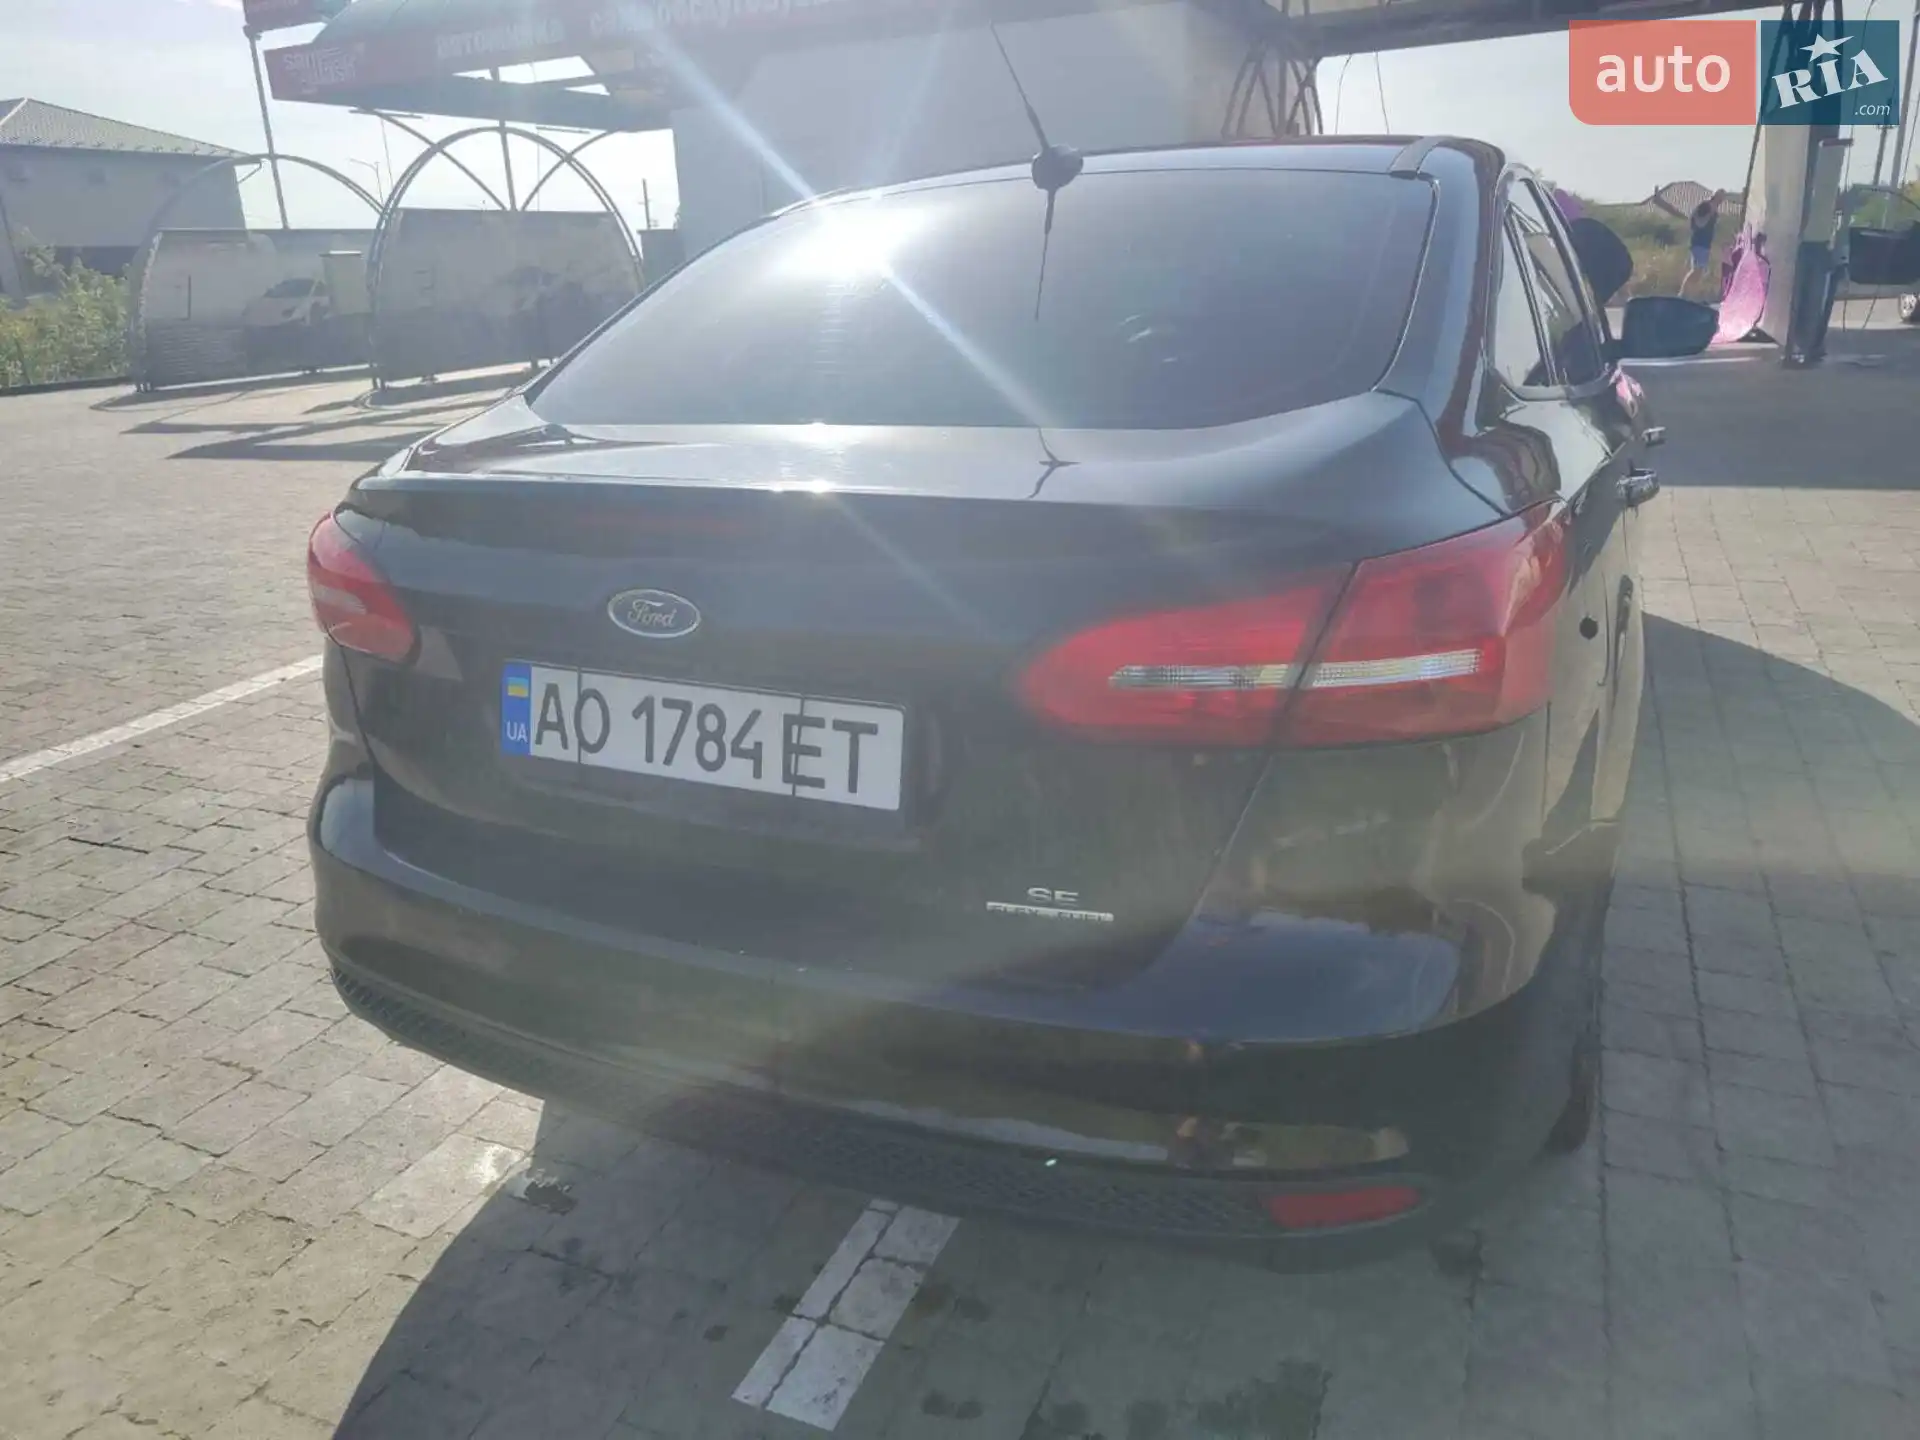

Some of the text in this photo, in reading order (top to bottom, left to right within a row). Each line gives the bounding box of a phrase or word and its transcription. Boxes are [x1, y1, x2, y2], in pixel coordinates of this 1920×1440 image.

[627, 598, 677, 629] Ford
[506, 721, 528, 742] UA
[534, 682, 879, 794] AO 1784 ET
[1027, 886, 1079, 907] SE
